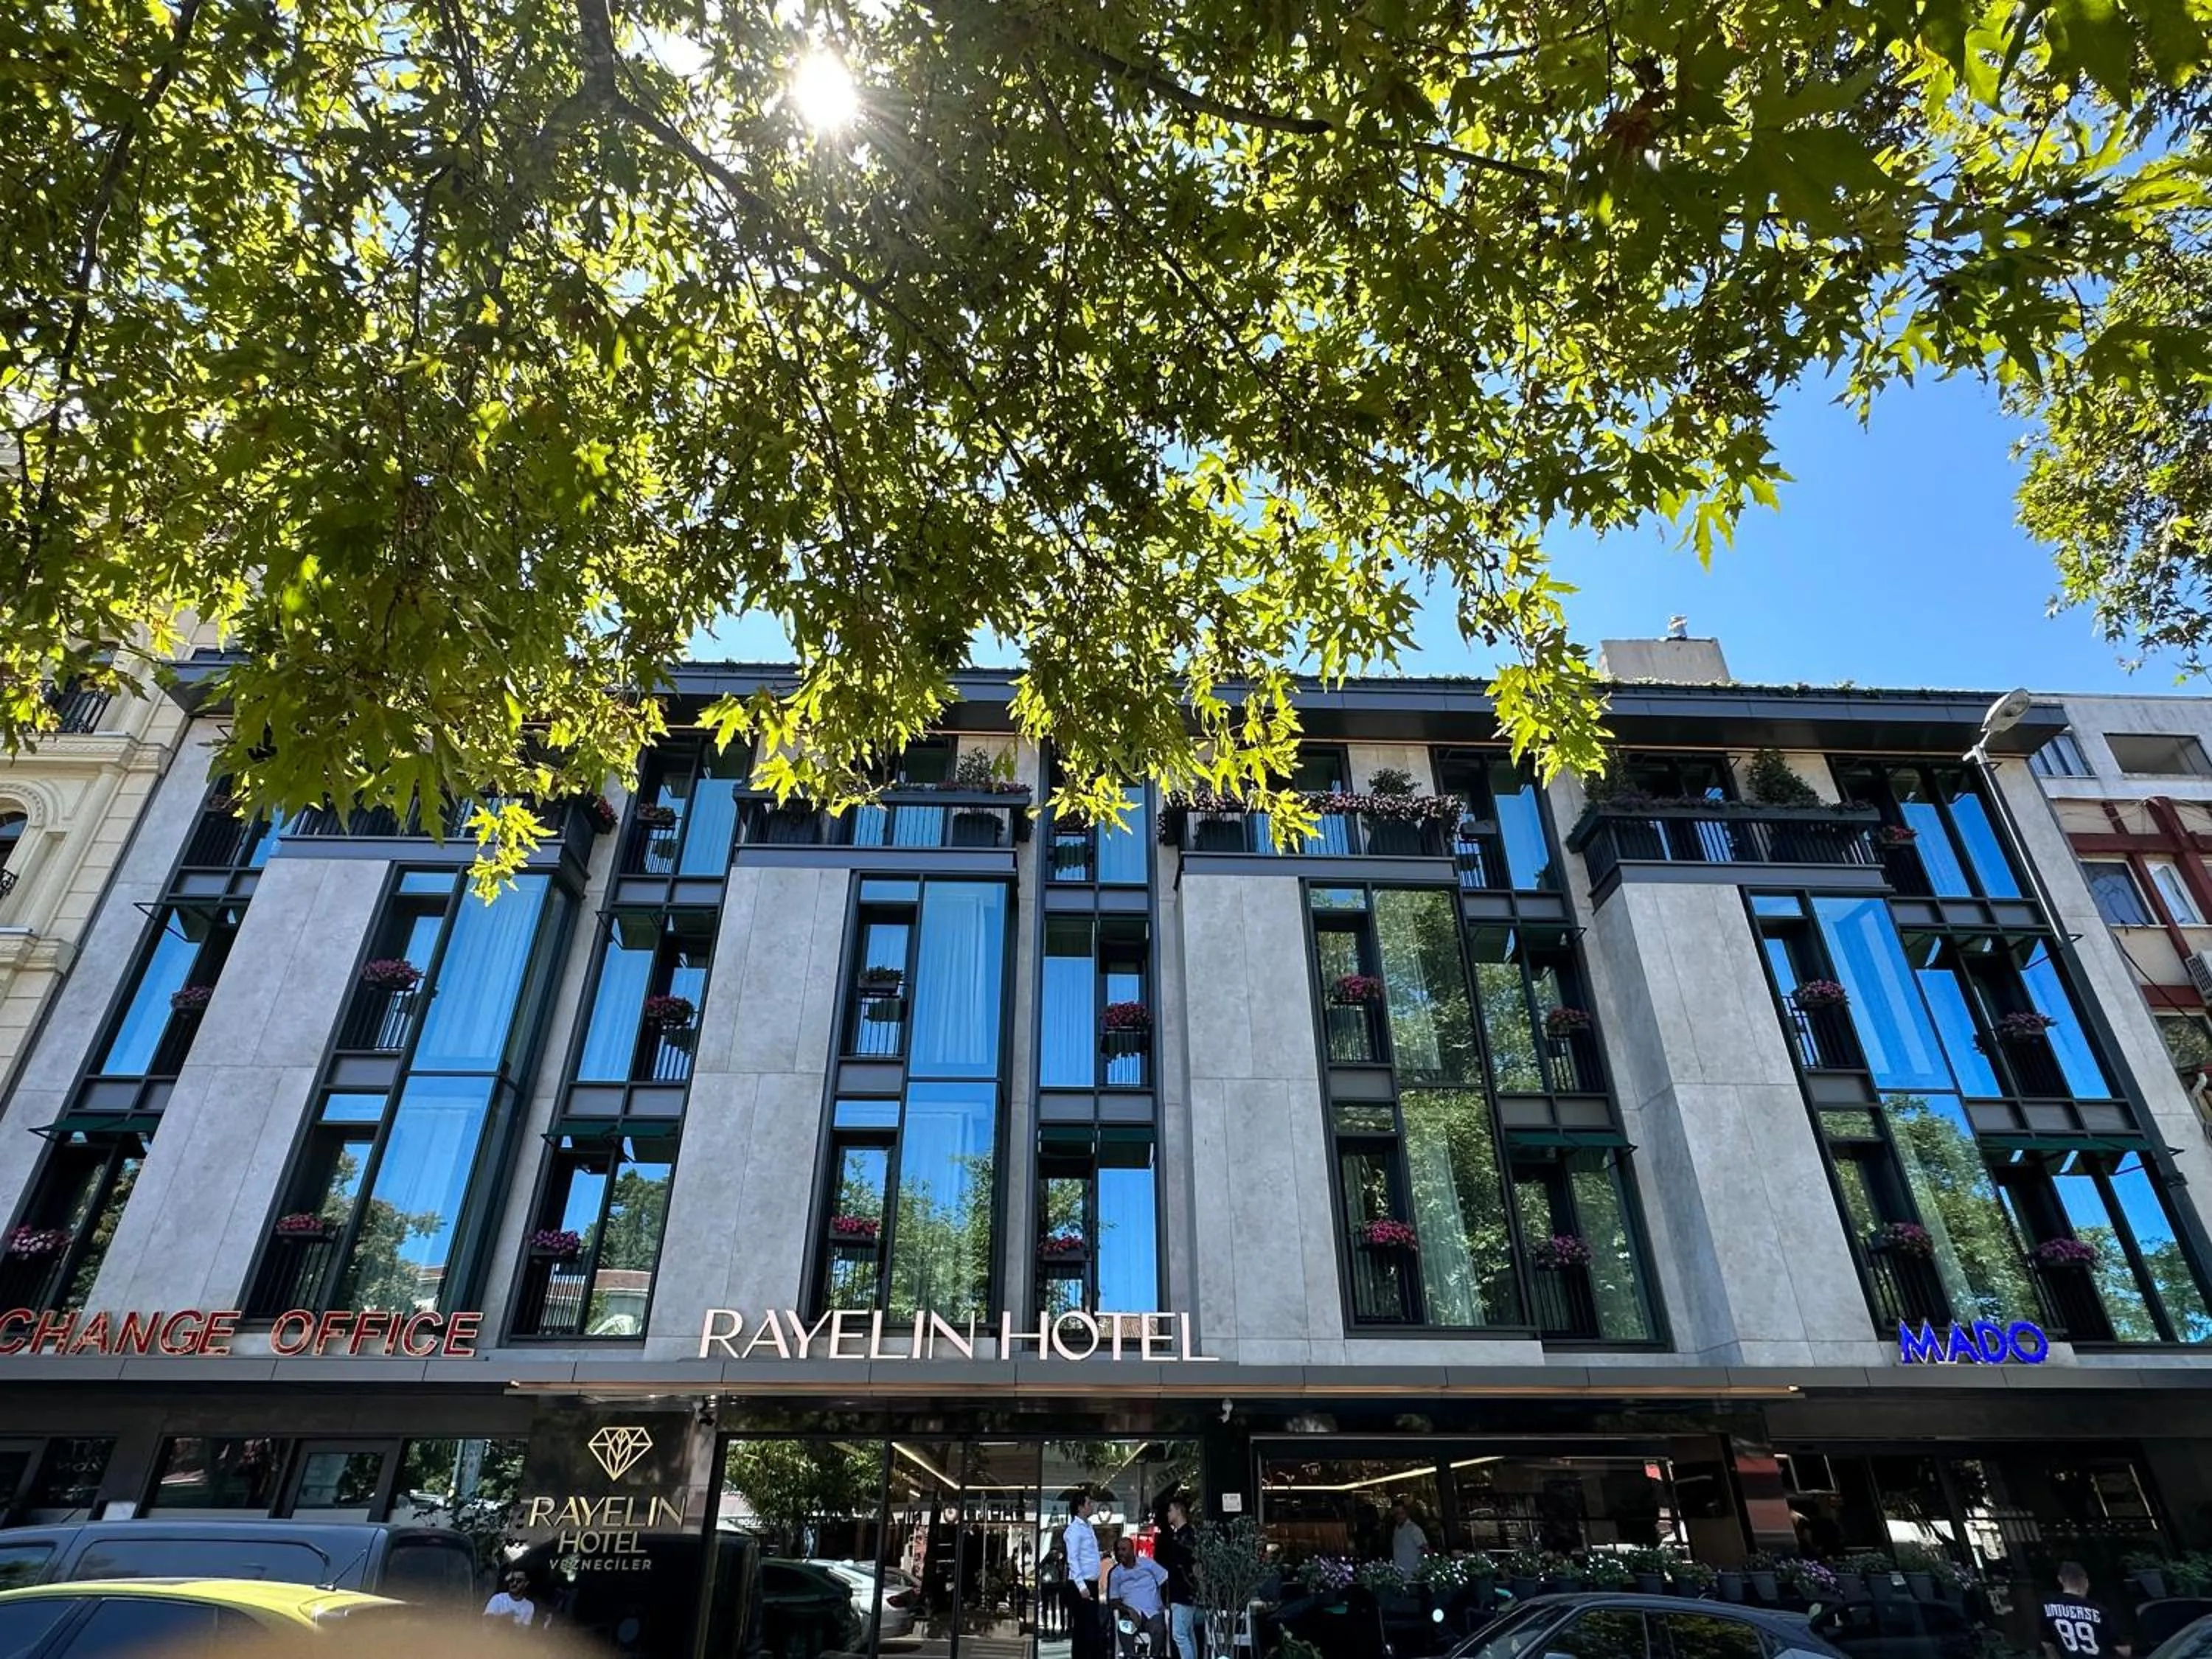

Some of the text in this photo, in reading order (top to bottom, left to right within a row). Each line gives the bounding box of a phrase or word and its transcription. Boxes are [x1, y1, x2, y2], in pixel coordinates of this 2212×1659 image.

[0, 1308, 484, 1357] CHANGE OFFICE
[698, 1309, 1220, 1361] RAYELIN HOTEL
[1898, 1318, 2050, 1364] MADO
[528, 1496, 686, 1528] RAYELIN
[557, 1530, 648, 1554] HOTEL
[2043, 1603, 2101, 1624] UNIVERSE
